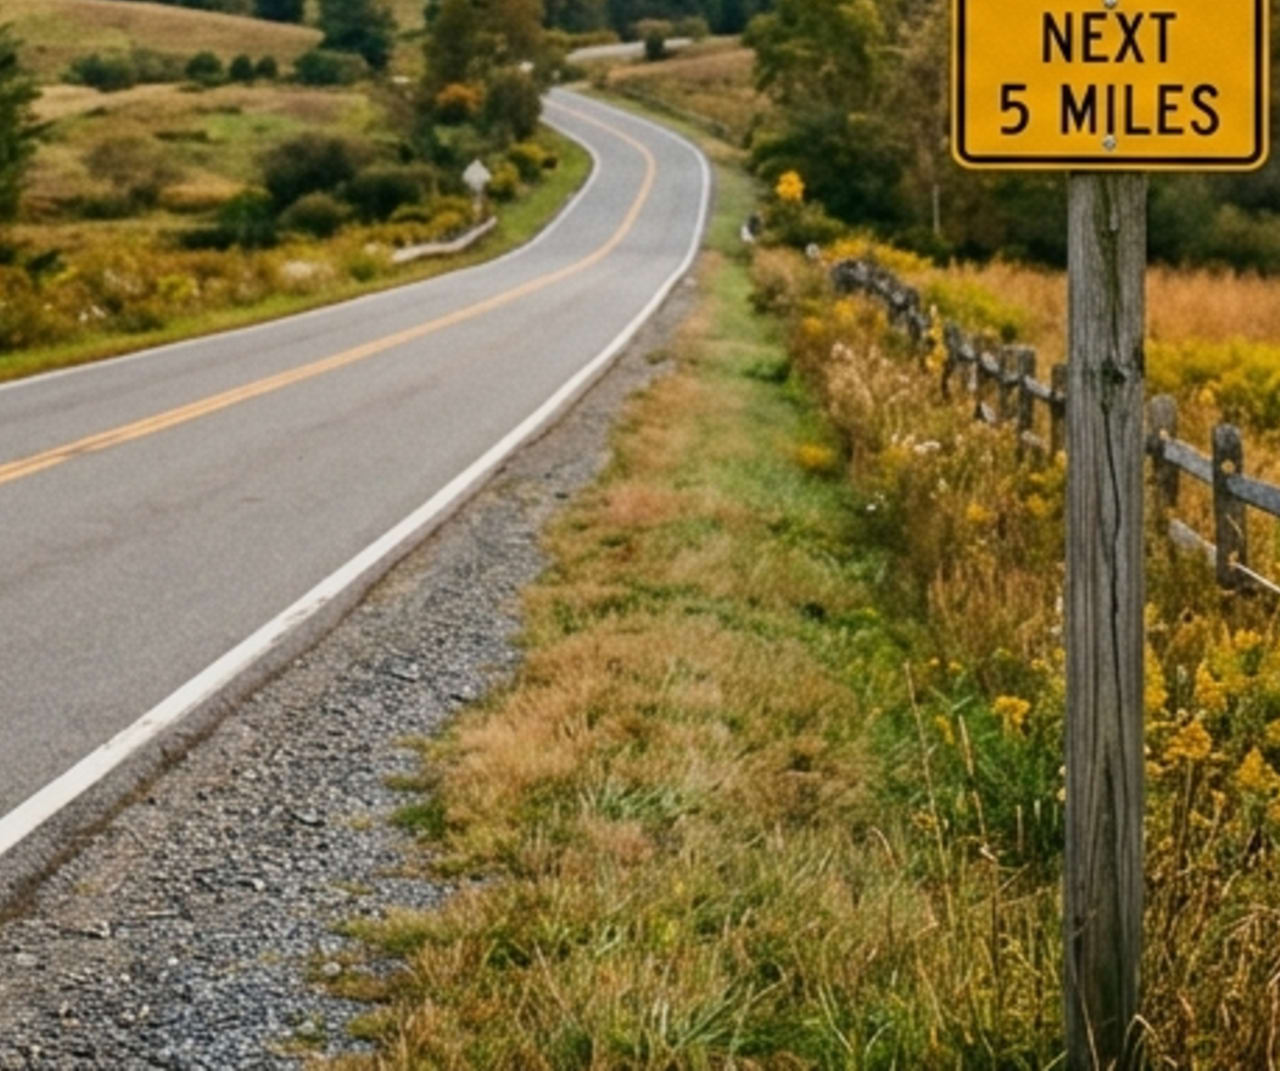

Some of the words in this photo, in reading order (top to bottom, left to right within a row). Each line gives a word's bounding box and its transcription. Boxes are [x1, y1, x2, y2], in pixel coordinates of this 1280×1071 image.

[1042, 11, 1176, 64] NEXT
[1000, 83, 1029, 136] 5
[1061, 83, 1220, 136] MILES
